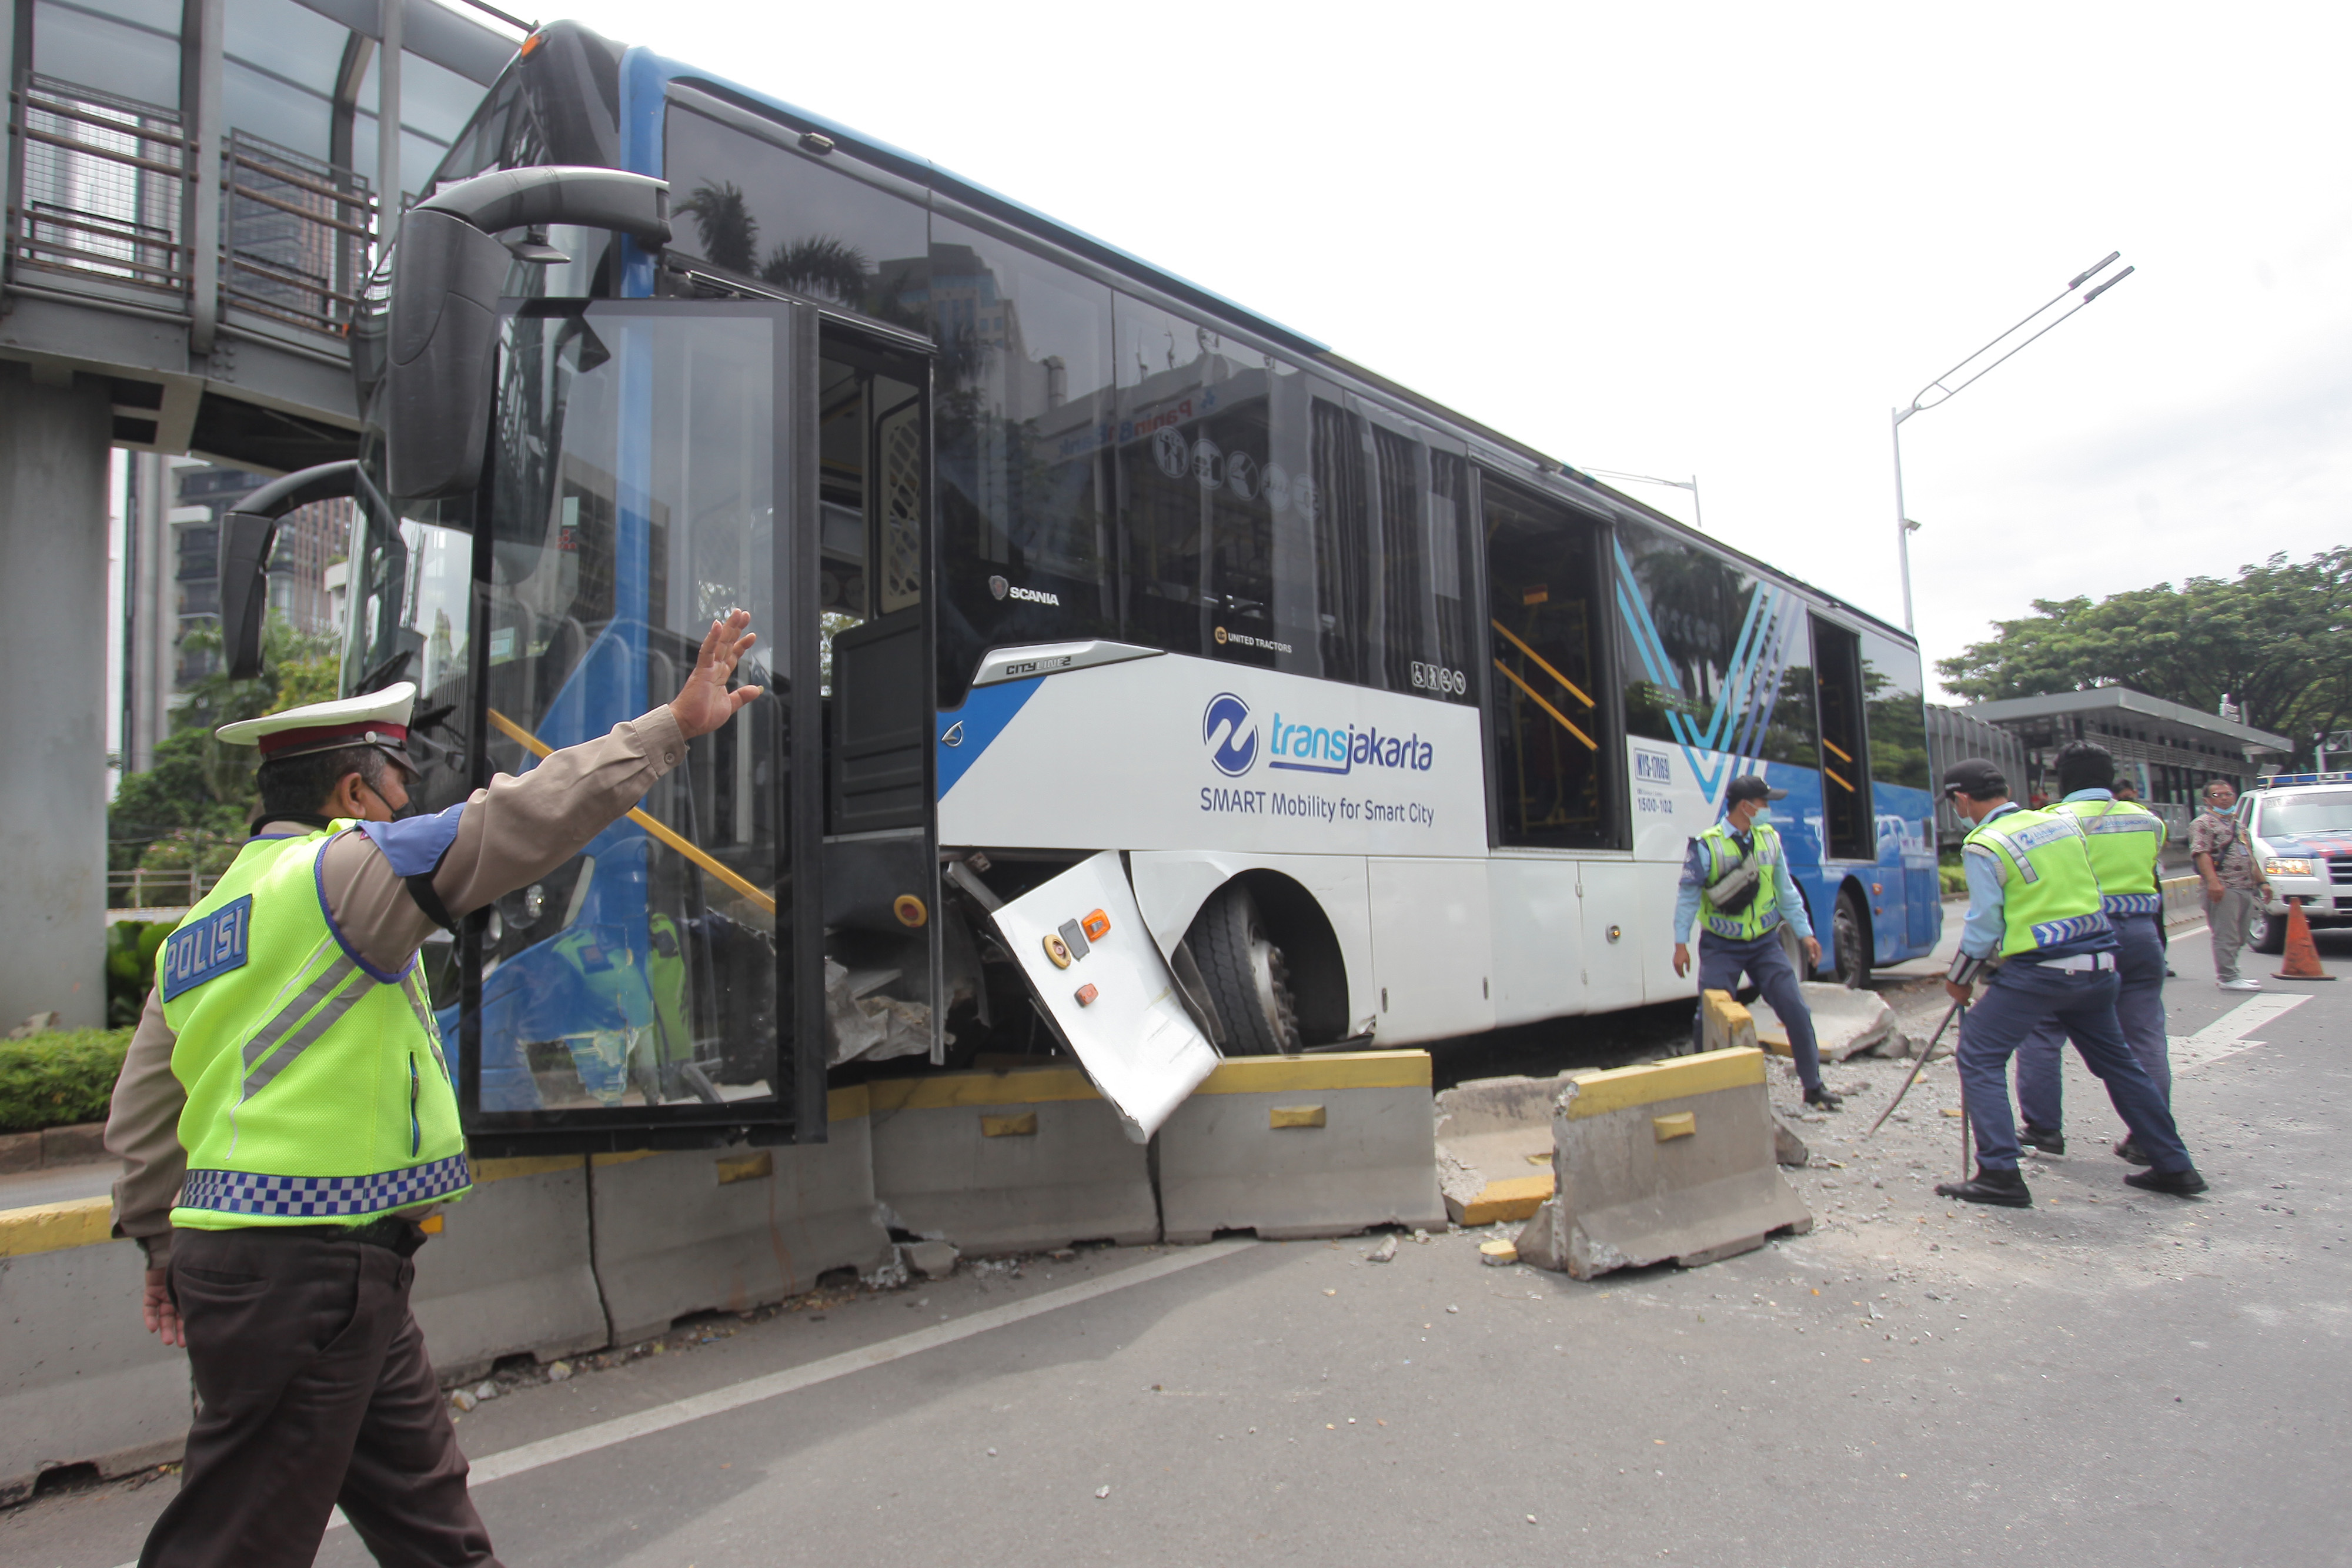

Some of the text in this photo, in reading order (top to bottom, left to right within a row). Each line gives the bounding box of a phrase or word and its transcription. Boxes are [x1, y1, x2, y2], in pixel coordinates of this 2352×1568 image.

[1010, 586, 1060, 606] SCANIA
[1228, 633, 1254, 646] UNITED
[1255, 638, 1292, 653] TRACTORS
[1269, 712, 1434, 774] transjakarta
[1201, 787, 1435, 828] SMART Mobility for Smart City
[164, 905, 245, 989] POLISI
